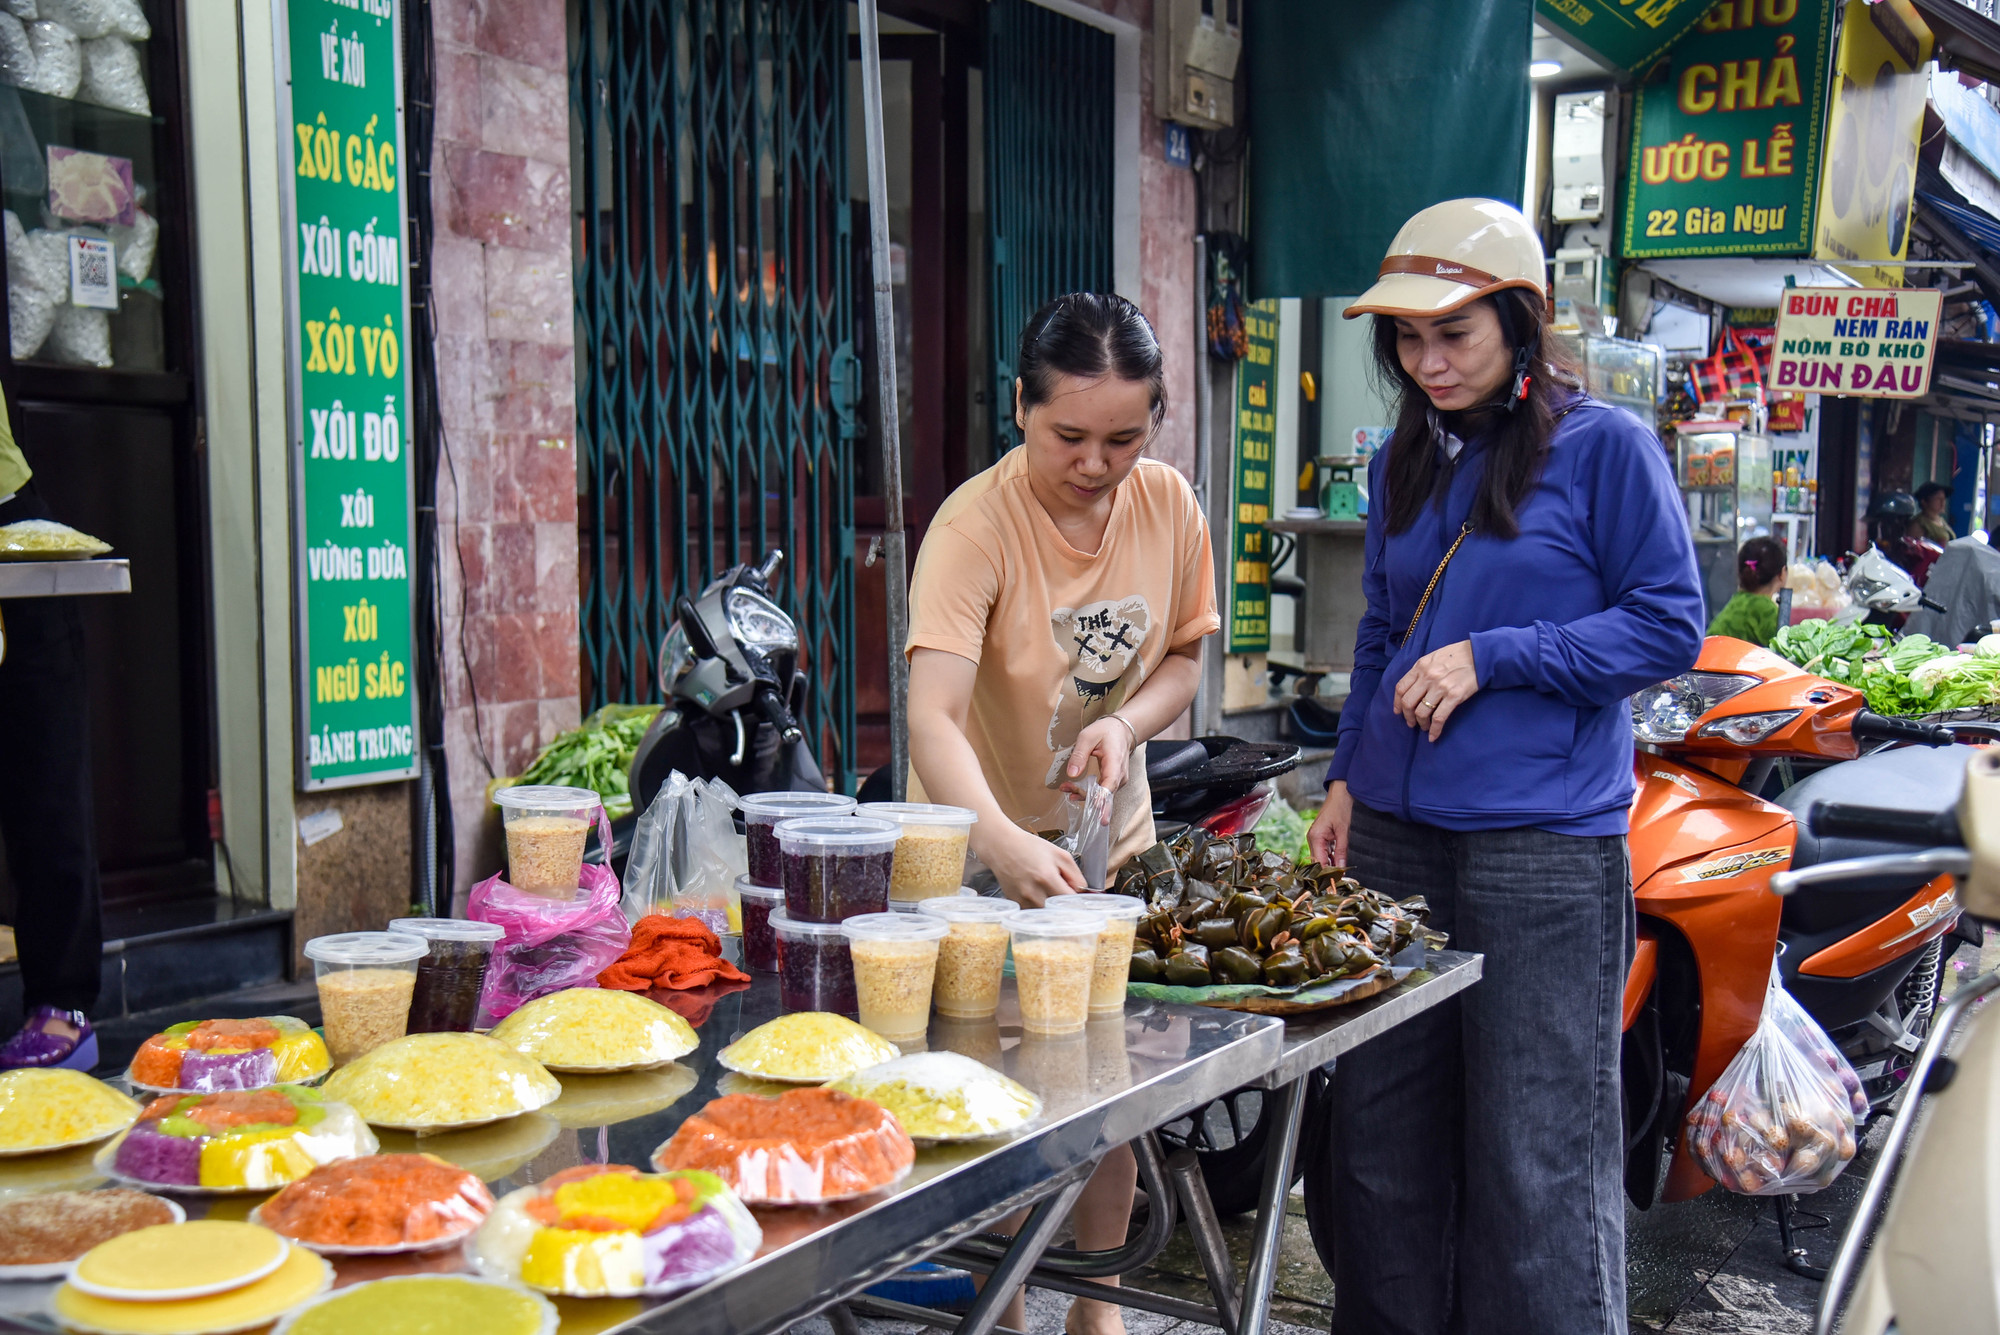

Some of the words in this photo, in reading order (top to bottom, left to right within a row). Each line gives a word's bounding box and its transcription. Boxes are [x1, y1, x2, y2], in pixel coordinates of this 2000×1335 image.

[320, 18, 340, 82] VỀ
[341, 30, 366, 88] XÔI
[1678, 34, 1802, 114] CHẢ
[296, 111, 342, 183] XÔI
[345, 113, 395, 193] GẤC
[1170, 129, 1187, 161] 24
[1642, 133, 1730, 184] ƯỚC
[1741, 122, 1794, 178] LỄ
[1645, 208, 1679, 237] 22
[1684, 206, 1727, 236] Gia
[1733, 204, 1788, 235] Ngư
[301, 215, 342, 278] XÔI
[347, 216, 399, 286] CỐM
[1787, 292, 1839, 316] BÚN
[1847, 292, 1899, 318] CHẢ
[305, 306, 356, 375] XÔI
[360, 313, 399, 379] VÒ
[1782, 338, 1832, 357] NỘM
[1839, 340, 1870, 357] BÒ
[1878, 341, 1925, 359] KHÔ
[1833, 318, 1879, 338] NEM
[1884, 317, 1929, 340] RÁN
[310, 399, 357, 460] XÔI
[363, 394, 400, 463] ĐỖ
[340, 488, 374, 528] XÔI
[308, 539, 363, 581] VỪNG
[367, 539, 407, 580] DỪA
[343, 597, 378, 642] XÔI
[1078, 608, 1111, 631] THE
[316, 657, 360, 704] NGŨ
[365, 650, 405, 699] SẮC
[309, 723, 356, 767] BÁNH
[357, 723, 412, 761] TRƯNG
[1652, 771, 1700, 798] HONDA
